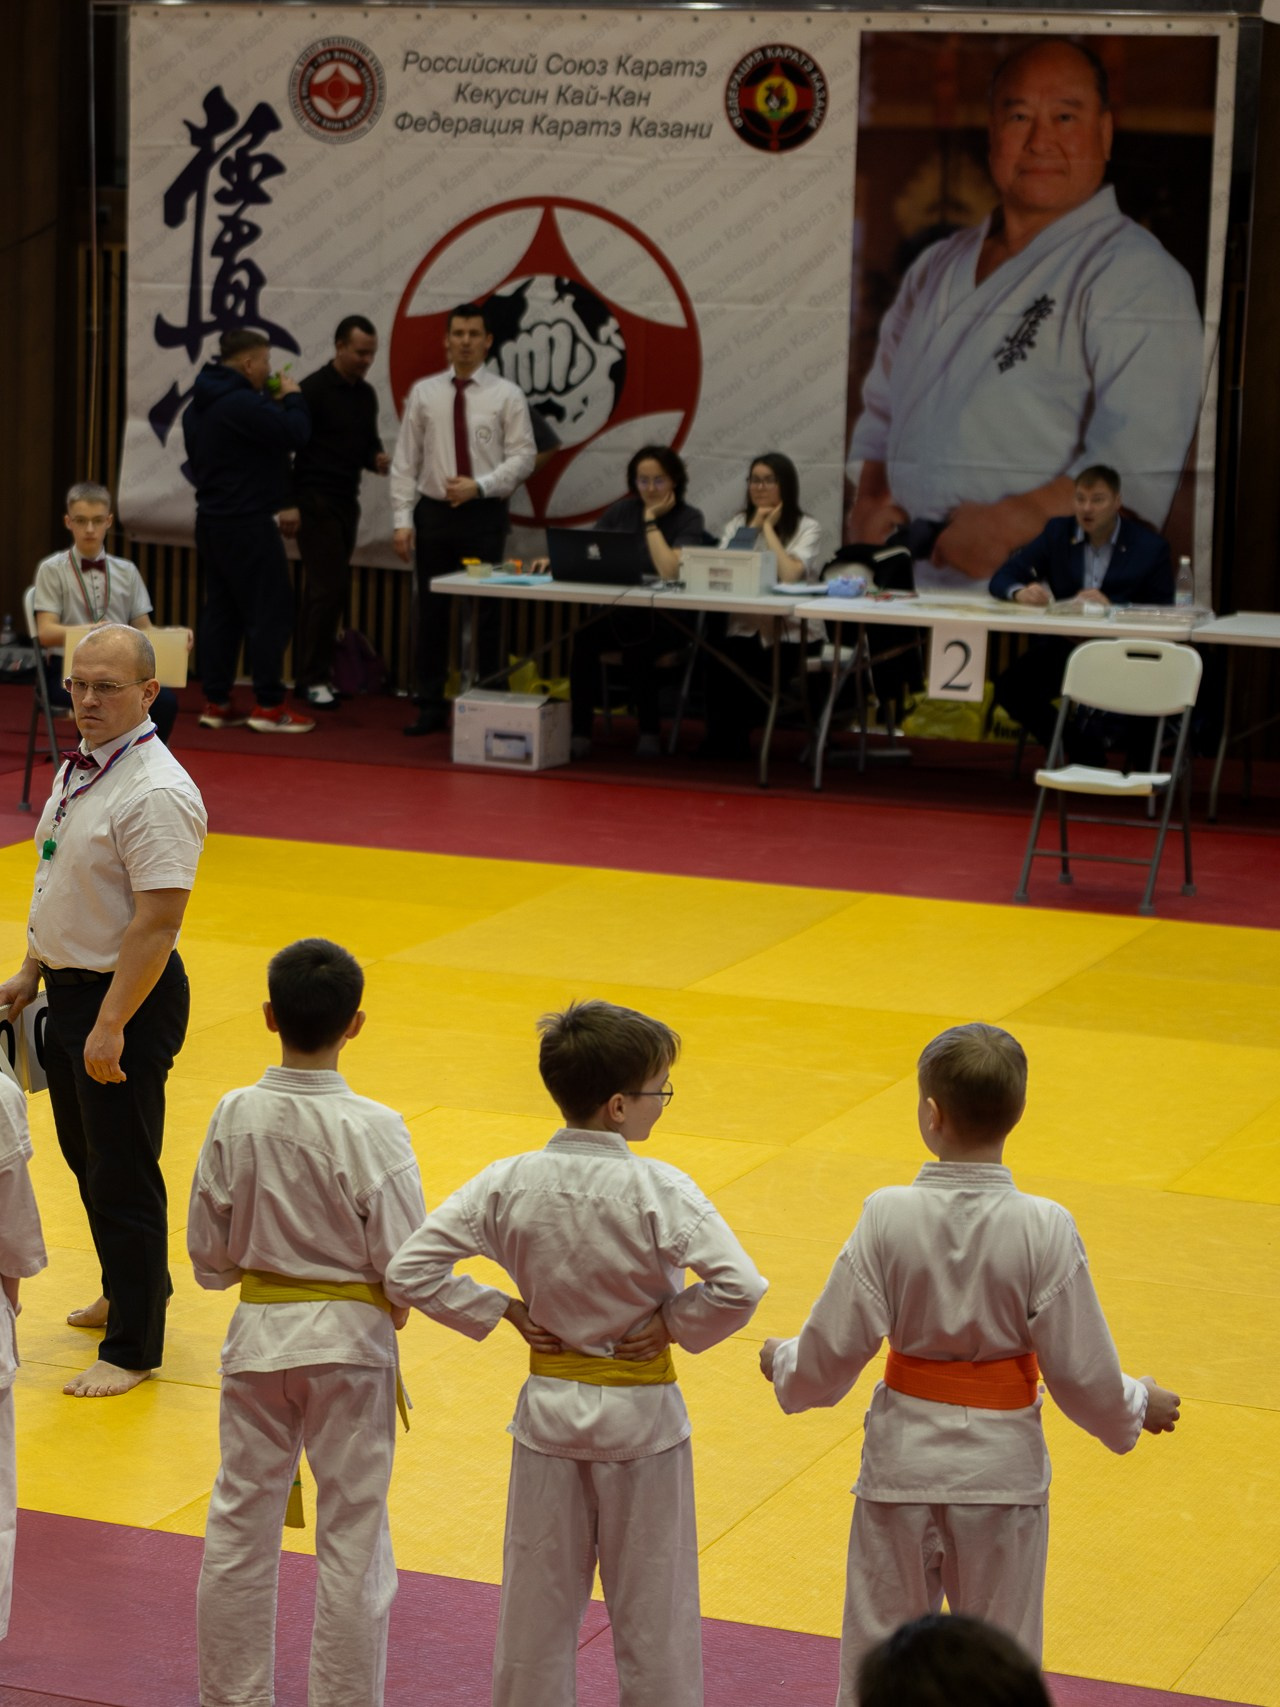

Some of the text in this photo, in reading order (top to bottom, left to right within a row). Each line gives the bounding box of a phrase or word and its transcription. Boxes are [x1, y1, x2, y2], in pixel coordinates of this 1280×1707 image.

[402, 50, 709, 81] Российский Союз Каратэ
[453, 82, 652, 110] Кекусин Кай-Кан
[727, 47, 827, 129] ФЕДЕРАЦИЯ КАРАТЭ КАЗАНИ
[394, 111, 714, 142] Федерация Каратэ Казани
[940, 639, 974, 692] 2
